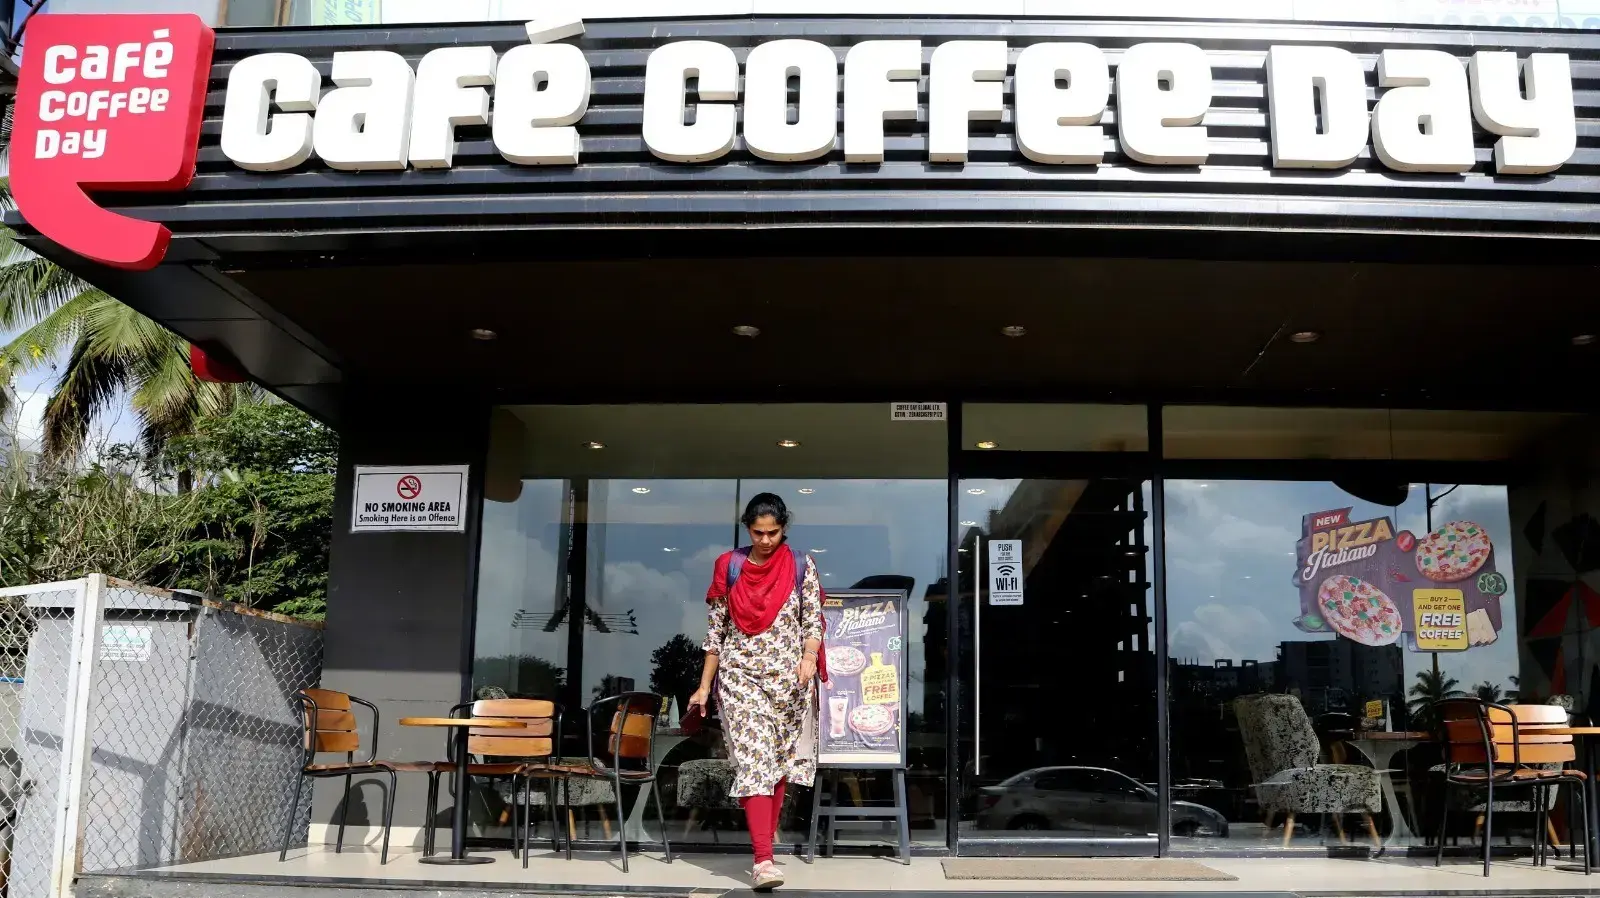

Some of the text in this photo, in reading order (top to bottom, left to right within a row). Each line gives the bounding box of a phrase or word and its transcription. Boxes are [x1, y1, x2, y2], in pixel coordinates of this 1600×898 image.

[34, 128, 107, 159] Day
[365, 501, 451, 512] NO SMOKING AREA
[359, 512, 456, 523] Smoking Here is an Offence
[1316, 514, 1341, 527] NEW
[1312, 519, 1393, 553] PIZZA
[997, 543, 1013, 551] PUSH
[1302, 544, 1377, 580] Italiano
[843, 601, 896, 620] PIZZA
[835, 615, 886, 638] Italiano
[1419, 612, 1462, 627] FREE
[864, 683, 896, 695] FREE
